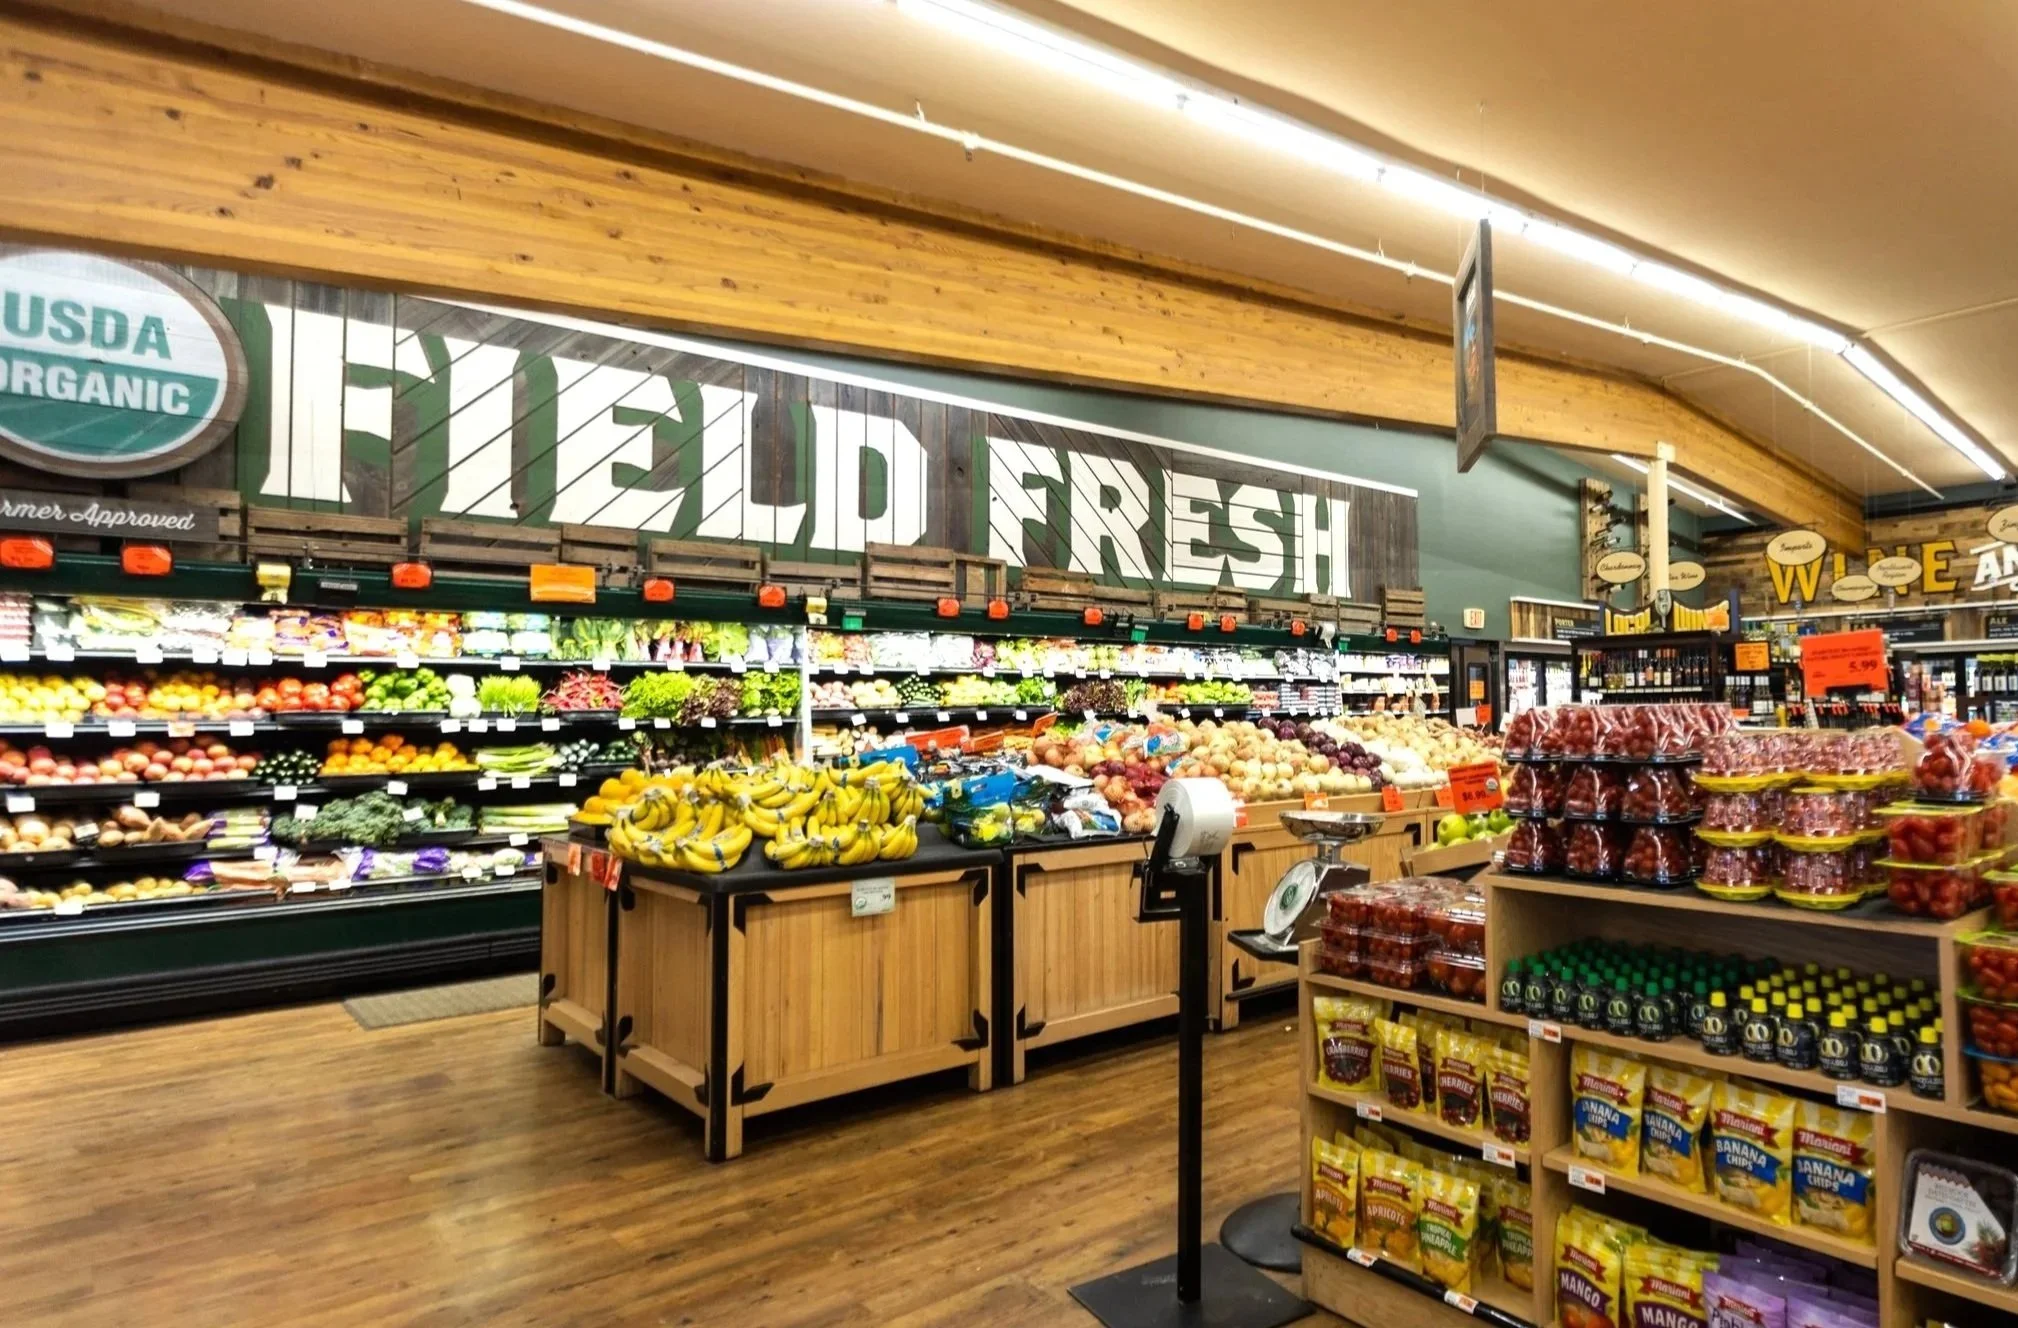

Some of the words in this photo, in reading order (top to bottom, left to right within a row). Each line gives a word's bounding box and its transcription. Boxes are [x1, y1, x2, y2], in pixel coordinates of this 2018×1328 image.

[4, 291, 172, 360] USDA
[0, 356, 190, 415] RGANIC
[259, 303, 929, 554] FIELD
[0, 499, 66, 521] rmer
[70, 501, 196, 531] Approved
[986, 436, 1351, 599] FRESH
[1780, 542, 1813, 554] Imports
[1600, 562, 1642, 572] Chardonnay
[1555, 617, 1574, 627] PORTER
[1849, 660, 1878, 673] 5.99
[1440, 1076, 1476, 1096] HERRIES
[1583, 1077, 1620, 1096] Mariani
[1720, 1112, 1765, 1136] Mariani
[1650, 1127, 1672, 1145] CHIPS
[1800, 1130, 1853, 1156] Mariani
[1716, 1139, 1767, 1168] BANANA
[1726, 1153, 1753, 1172] CHIPS
[1796, 1159, 1856, 1187] BANANA
[1807, 1174, 1840, 1192] CHIPS
[1372, 1178, 1403, 1194] Mariani
[1366, 1205, 1405, 1226] APRICOTS
[1427, 1199, 1457, 1220] Mariani
[1569, 1248, 1598, 1272] Mariani
[1561, 1272, 1600, 1309] MANGO
[1651, 1279, 1690, 1300] Mariani
